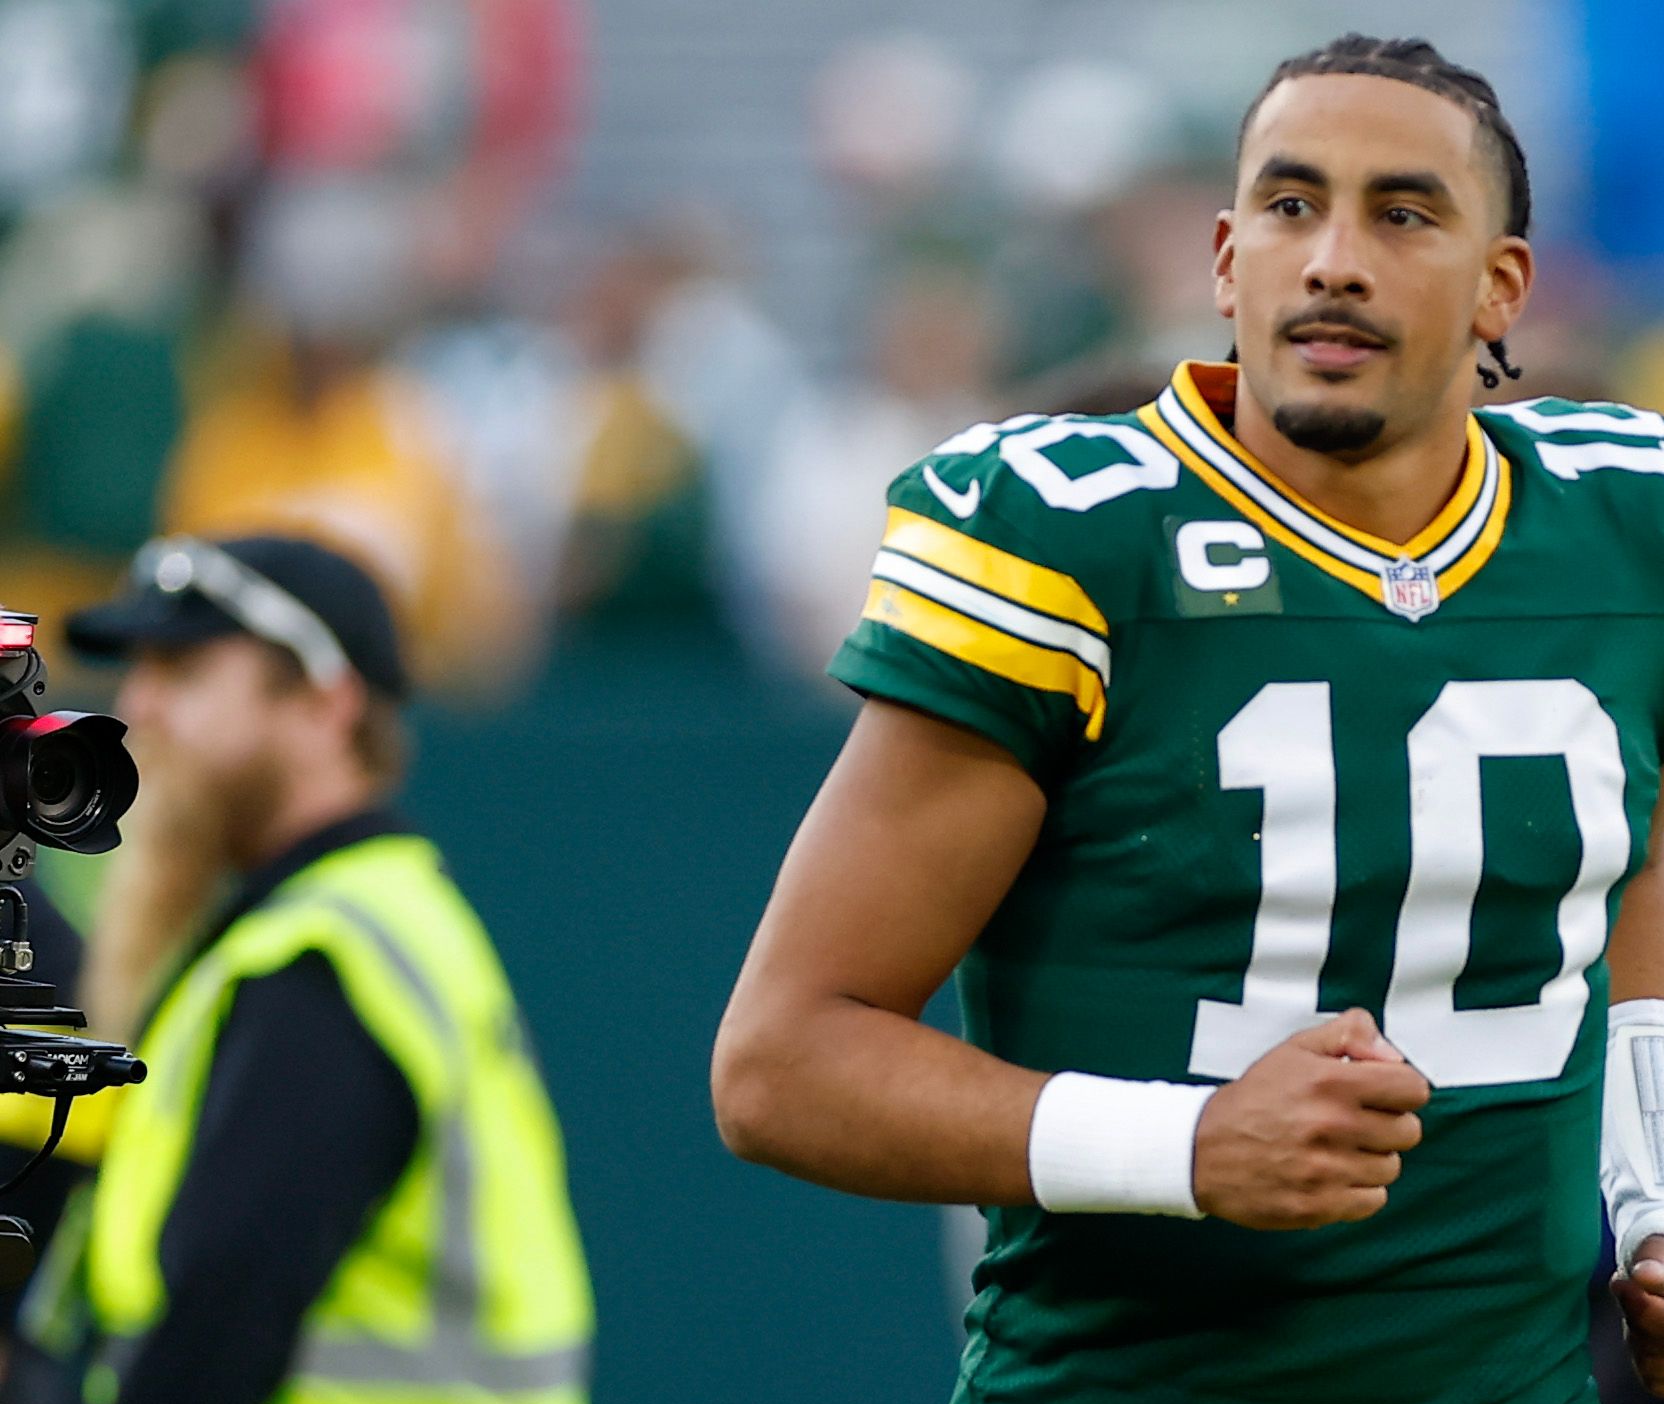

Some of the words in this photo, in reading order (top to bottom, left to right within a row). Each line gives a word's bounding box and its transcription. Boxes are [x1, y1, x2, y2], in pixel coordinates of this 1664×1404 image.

[1176, 520, 1271, 591] C
[1395, 583, 1431, 608] NFL
[1187, 678, 1632, 1089] 10
